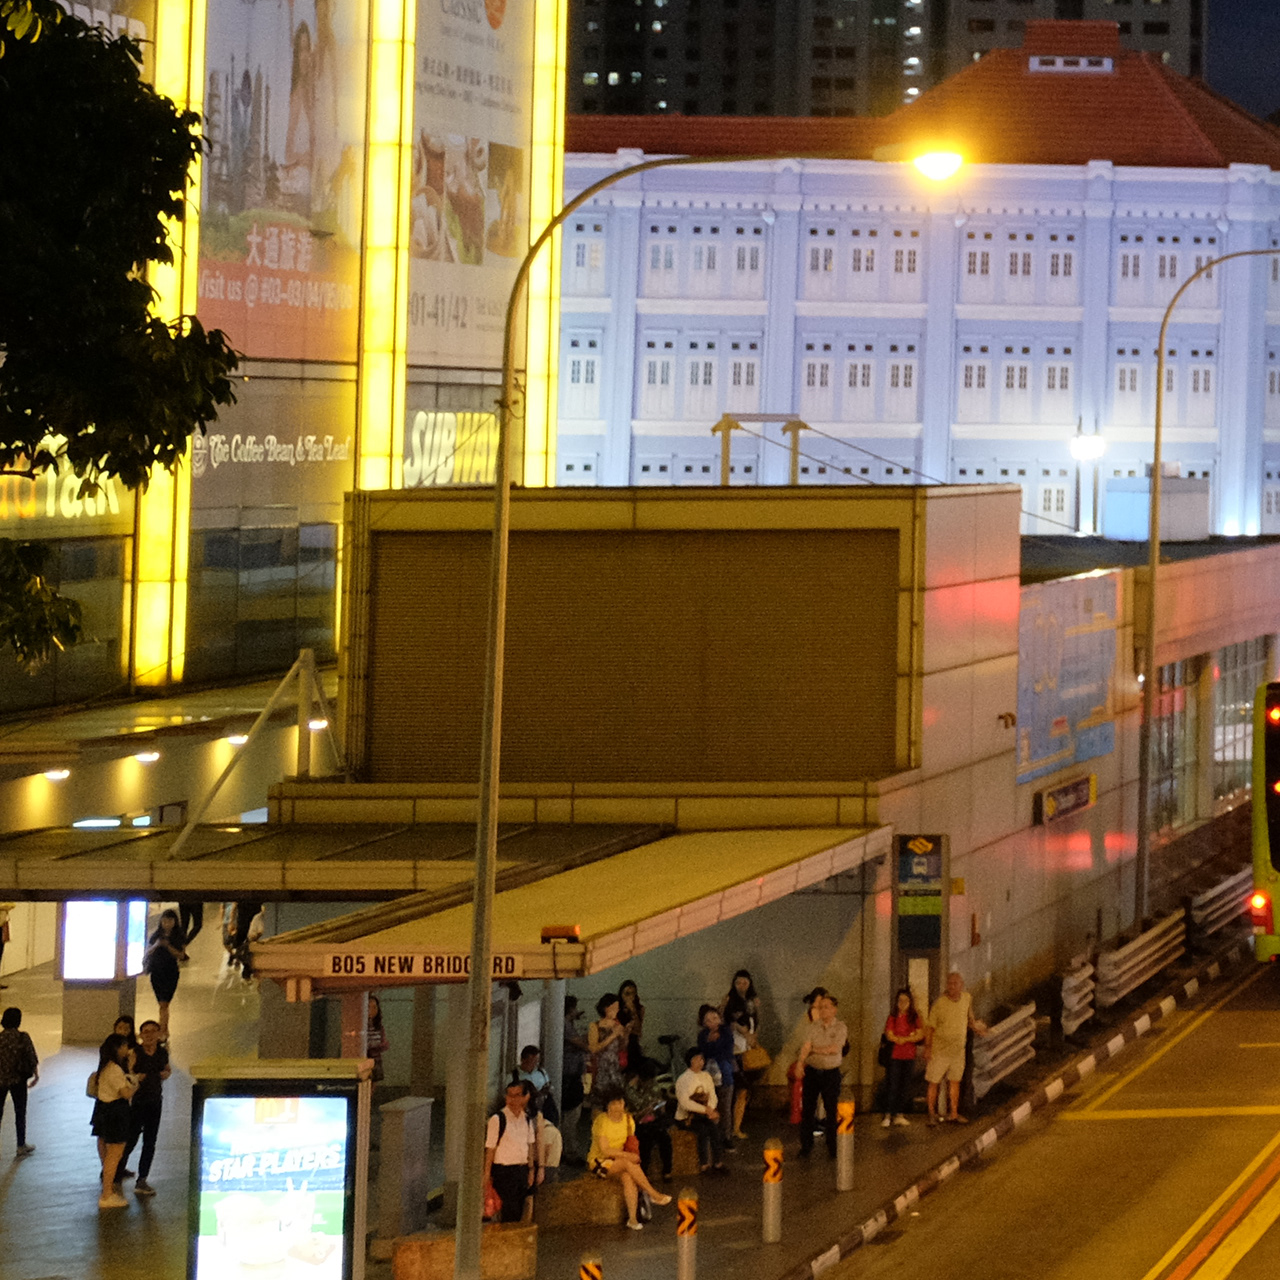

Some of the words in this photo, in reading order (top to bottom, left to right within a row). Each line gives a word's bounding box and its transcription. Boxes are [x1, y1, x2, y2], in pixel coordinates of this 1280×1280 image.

[227, 278, 243, 302] us
[209, 434, 230, 469] The
[231, 434, 265, 463] Coffee
[264, 434, 296, 467] Bean
[304, 434, 324, 462] Tea
[323, 434, 352, 462] Leaf
[374, 956, 414, 974] NEW
[422, 955, 472, 975] BRIDG
[492, 956, 515, 973] RD
[208, 1155, 258, 1183] STAR
[258, 1142, 344, 1176] PLAYERS
